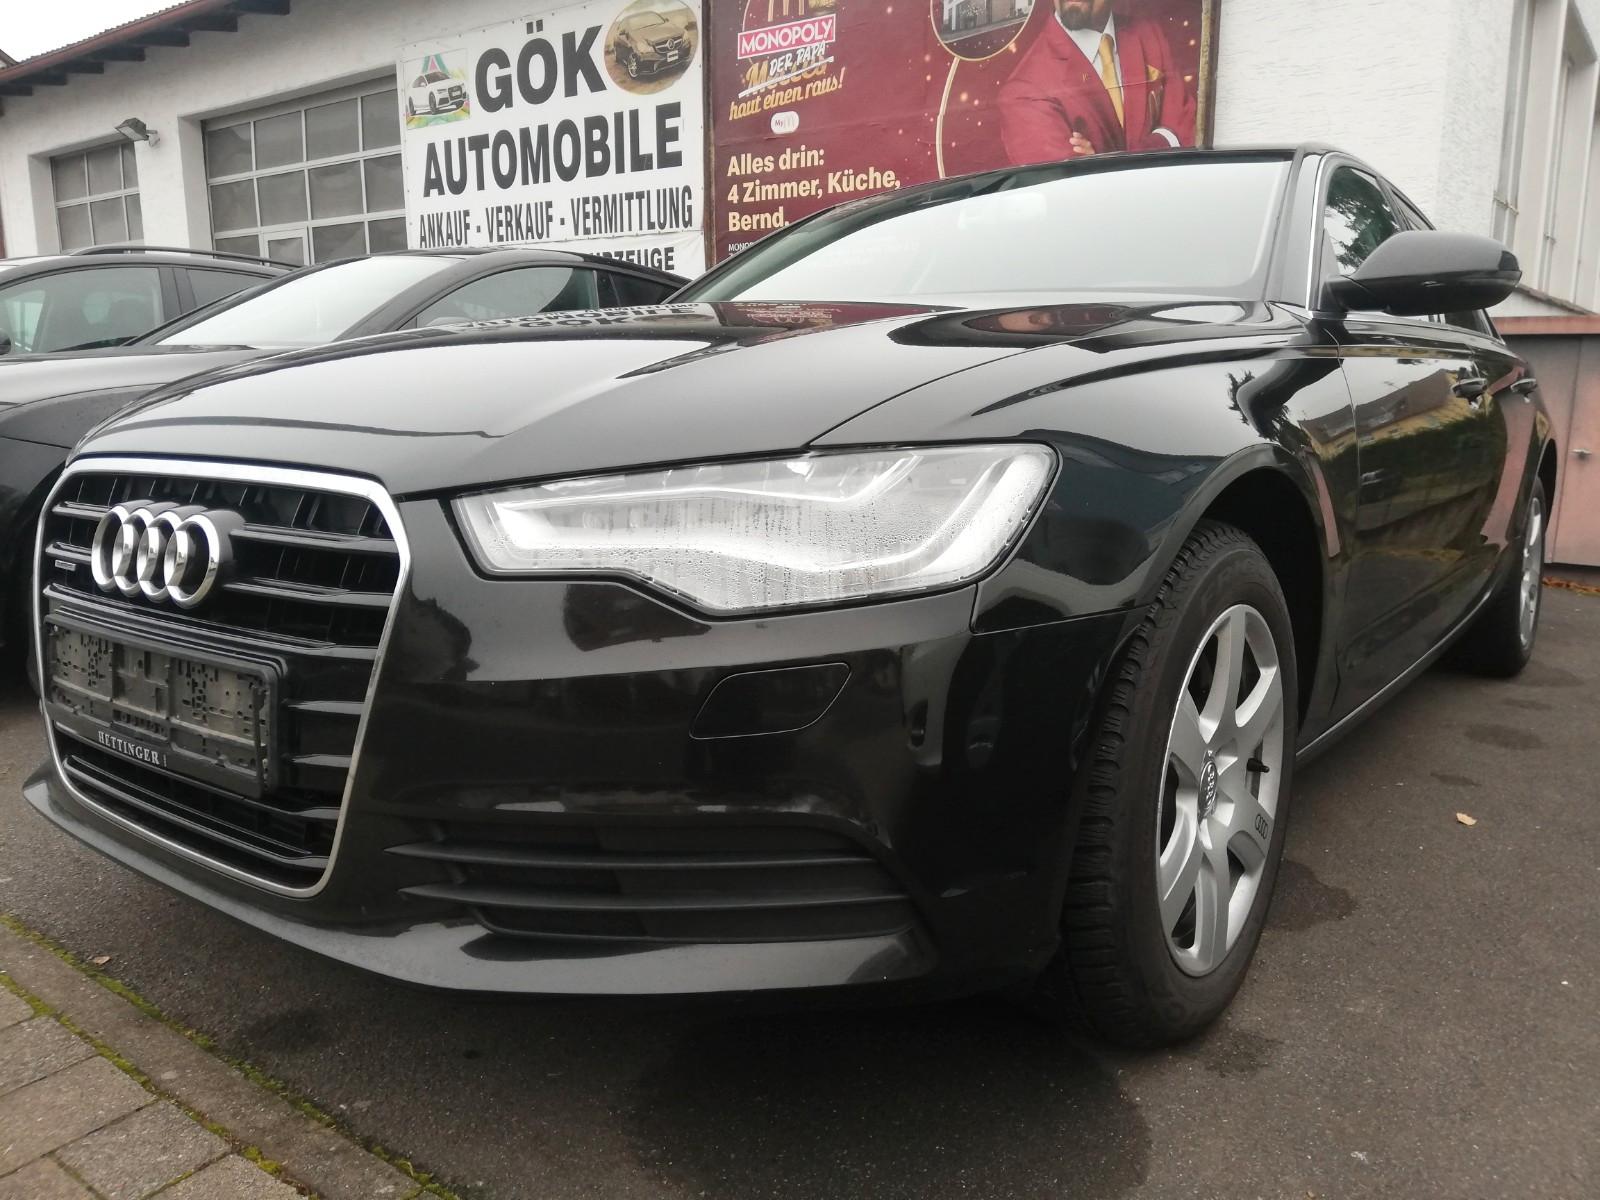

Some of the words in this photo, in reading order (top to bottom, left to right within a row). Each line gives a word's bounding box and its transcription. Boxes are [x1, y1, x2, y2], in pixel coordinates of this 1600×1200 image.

[741, 19, 833, 54] MONOPOLY
[475, 20, 607, 113] GÖK
[769, 53, 793, 76] DER
[796, 42, 826, 66] PAPA
[729, 98, 761, 121] haut
[763, 86, 803, 109] einen
[805, 67, 846, 97] raus!
[423, 101, 683, 198] AUTOMOBILE
[727, 152, 774, 177] Alles
[779, 145, 825, 171] drin:
[727, 184, 739, 204] 4
[742, 179, 823, 204] Zimmer,
[828, 166, 901, 194] Küche,
[419, 209, 471, 249] ANKAUF
[485, 200, 553, 243] VERKAUF
[570, 185, 693, 236] VERMITTLUNG
[728, 206, 790, 232] Bernd.
[97, 731, 160, 765] HETTINGER
